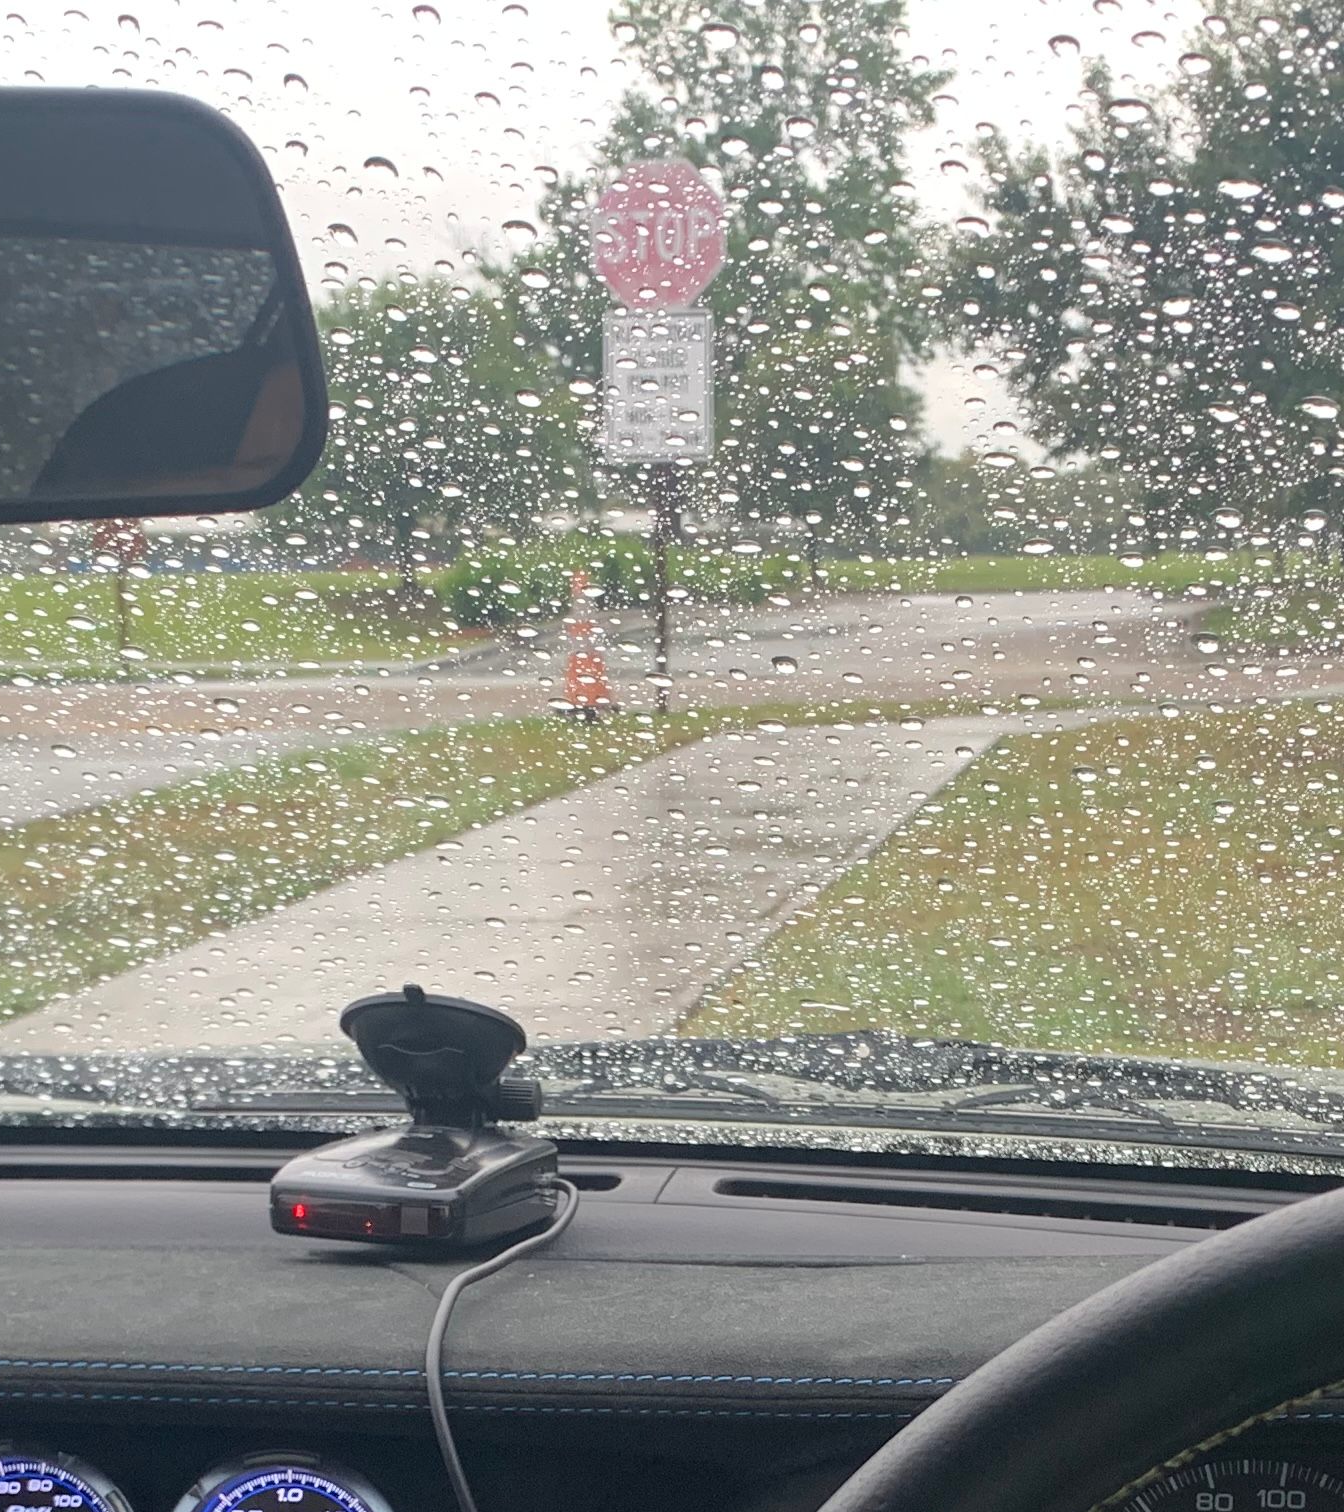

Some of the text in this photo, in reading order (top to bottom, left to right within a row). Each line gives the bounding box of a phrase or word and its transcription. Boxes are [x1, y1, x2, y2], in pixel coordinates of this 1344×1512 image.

[592, 210, 715, 263] STOP
[54, 1495, 82, 1508] 100
[276, 1488, 304, 1502] 1.0
[1196, 1493, 1234, 1511] 80
[1257, 1489, 1305, 1508] 100
